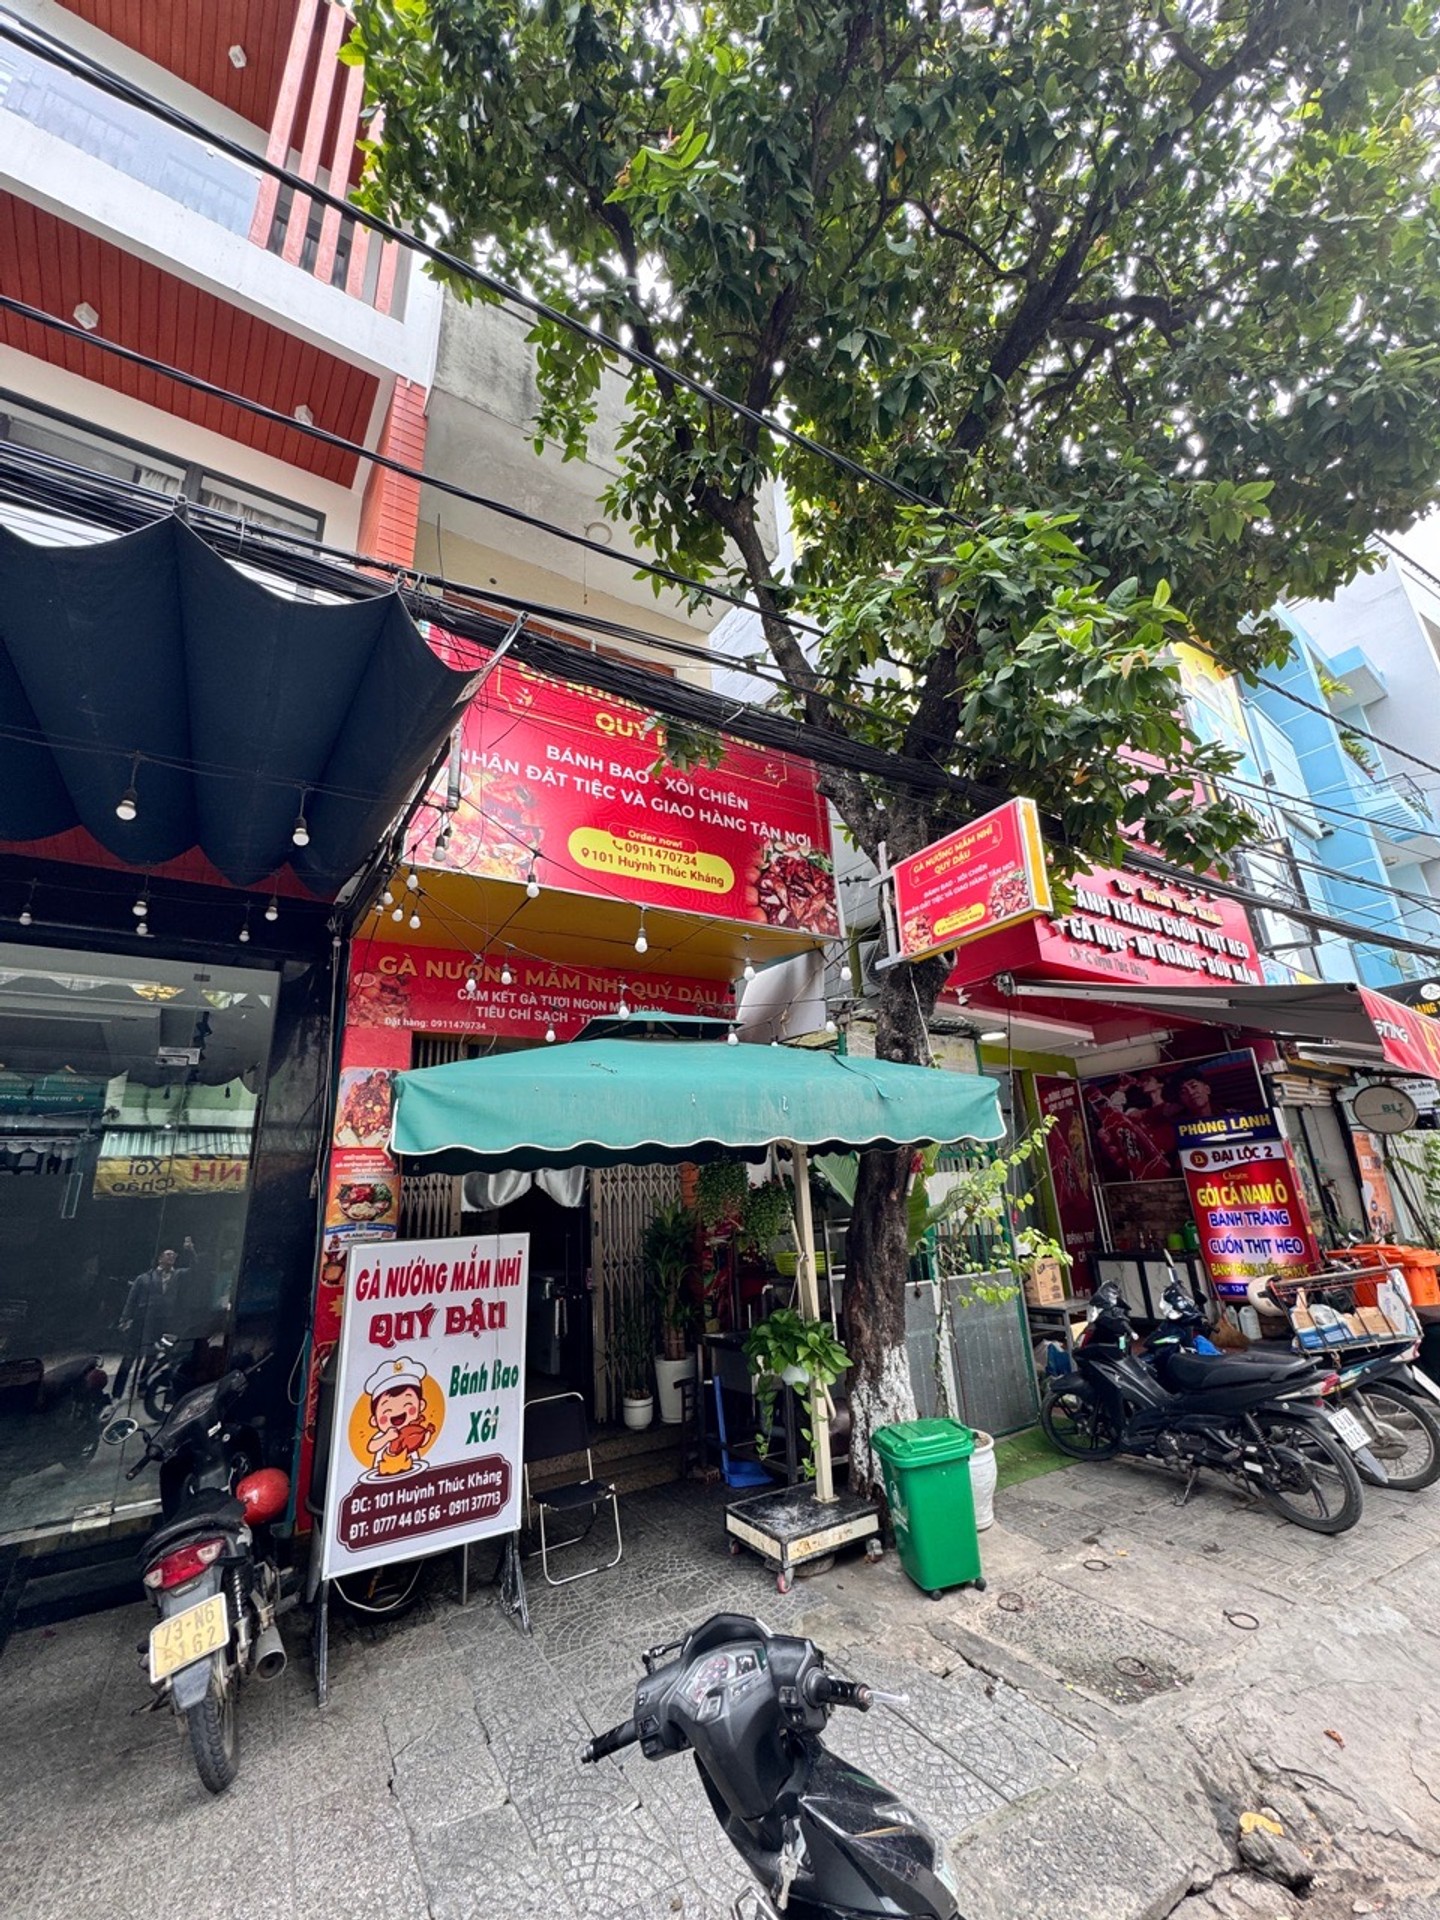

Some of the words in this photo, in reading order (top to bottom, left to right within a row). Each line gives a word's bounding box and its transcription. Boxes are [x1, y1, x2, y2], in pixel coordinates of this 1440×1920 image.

[546, 745, 604, 772] BÁNH
[609, 762, 649, 784] BAO
[665, 777, 695, 796] XÔI
[699, 788, 748, 811] CHIÊN
[460, 749, 520, 775] NHẬN
[525, 765, 568, 787] ĐẶT
[573, 777, 615, 799] TIỆC
[620, 789, 647, 808] VÀ
[651, 797, 695, 819] GIAO
[699, 809, 747, 831] HÀNG
[750, 821, 781, 840] TẬN
[784, 830, 812, 848] NƠI
[625, 842, 697, 867] 0911470734
[627, 830, 657, 843] Order
[658, 837, 683, 849] now!
[592, 850, 614, 864] 101
[618, 855, 656, 872] Huỳnh
[659, 863, 687, 879] Thúc
[690, 870, 725, 888] Kháng
[379, 953, 418, 976] GÀ
[631, 980, 673, 1001] QUÝ
[475, 1004, 506, 1019] TIÊU
[508, 1006, 531, 1020] CHÍ
[534, 1009, 568, 1024] SẠCH
[491, 987, 518, 1004] KẾT
[519, 991, 538, 1006] GÀ
[573, 997, 607, 1011] NGON
[384, 1017, 401, 1028] Đặt
[403, 1017, 429, 1029] hàng:
[1178, 1120, 1228, 1137] PHÒNG
[1230, 1113, 1271, 1131] LẠNH
[1212, 1149, 1234, 1164] ĐẠI
[1236, 1146, 1261, 1161] LỘC
[1264, 1146, 1274, 1158] 2
[1220, 1181, 1241, 1206] CÁ
[1240, 1183, 1275, 1205] NAM
[1274, 1178, 1288, 1204] Ô
[1208, 1207, 1243, 1228] BÁNH
[1243, 1206, 1291, 1227] TRÁNG
[1209, 1234, 1245, 1255] CUỐN
[1244, 1238, 1272, 1257] THỊT
[1275, 1237, 1304, 1255] HEO
[355, 1259, 381, 1301] GÀ
[385, 1255, 448, 1299] NƯỚNG
[450, 1244, 491, 1292] MẮM
[369, 1302, 439, 1350] QUÝ
[449, 1361, 488, 1397] Bánh
[491, 1359, 519, 1391] Bao
[465, 1405, 499, 1446] Xôi
[351, 1498, 371, 1515] ĐC:
[374, 1492, 394, 1509] 101
[396, 1483, 435, 1505] Huỳnh
[437, 1476, 465, 1495] Thúc
[467, 1470, 503, 1489] Kháng
[350, 1523, 369, 1540] ĐT:
[373, 1515, 398, 1534] 0777
[398, 1511, 412, 1527] 44
[414, 1508, 426, 1524] 05
[428, 1505, 441, 1521] 66
[449, 1498, 469, 1516] 0911
[471, 1490, 501, 1511] 377713
